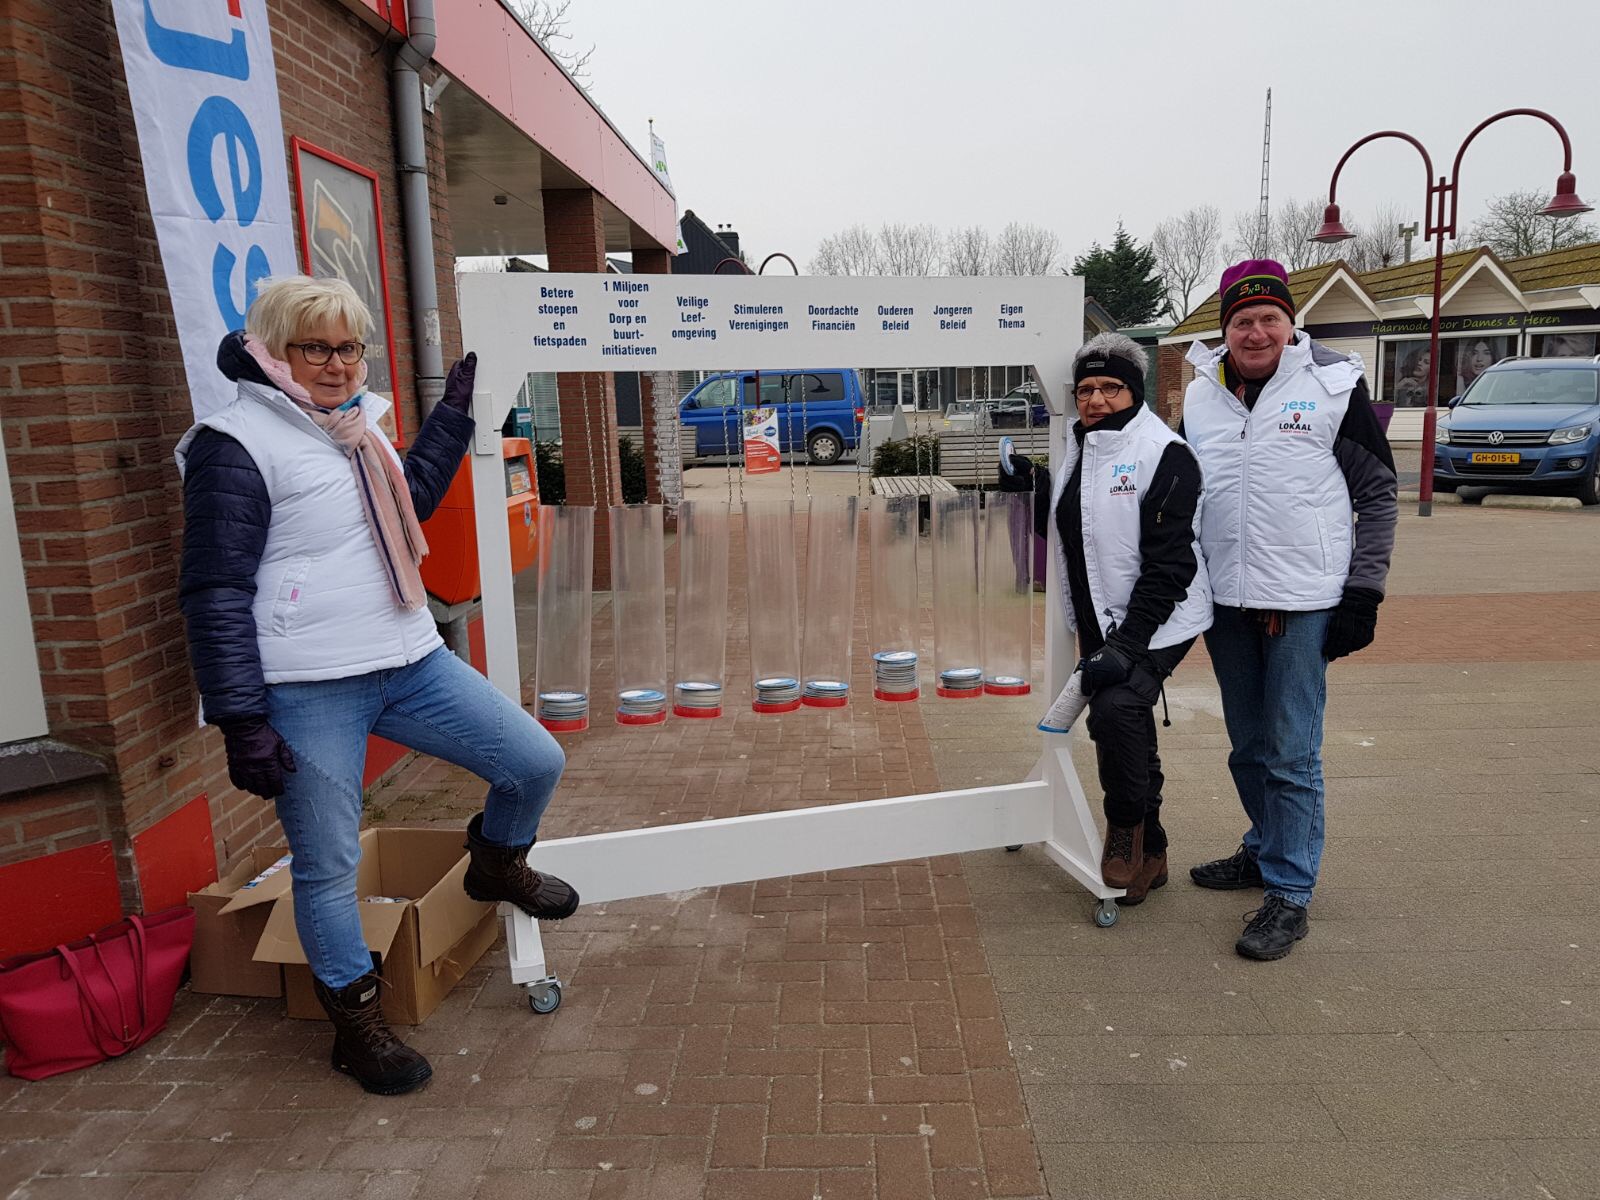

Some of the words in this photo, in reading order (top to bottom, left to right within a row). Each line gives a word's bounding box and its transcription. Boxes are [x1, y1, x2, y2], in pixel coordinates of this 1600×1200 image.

[540, 287, 574, 299] Betere
[603, 282, 609, 293] 1
[612, 281, 649, 294] Miljoen
[617, 299, 639, 308] voor
[676, 296, 709, 309] Veilige
[538, 303, 578, 316] stoepen
[733, 303, 784, 315] Stimuleren
[808, 304, 859, 316] Doordachte
[877, 305, 914, 316] Ouderen
[933, 305, 973, 317] Jongeren
[1000, 304, 1024, 316] Eigen
[609, 313, 632, 326] Dorp
[635, 315, 647, 324] en
[681, 312, 706, 323] Leef-
[998, 318, 1026, 329] Thema
[1372, 320, 1429, 333] Haarmode
[1439, 320, 1459, 330] oor
[1463, 318, 1502, 329] Dames
[1507, 316, 1518, 326] &
[1523, 314, 1561, 326] Heren
[553, 321, 566, 331] en
[728, 319, 789, 332] Verenigingen
[812, 319, 856, 331] Financiën
[882, 321, 910, 331] Beleid
[940, 319, 967, 330] Beleid
[613, 329, 645, 340] buurt-
[671, 328, 717, 341] omgeving
[533, 335, 587, 348] fietspaden
[602, 345, 657, 356] initiatieven
[1281, 400, 1316, 413] jess
[1279, 422, 1313, 432] LOKAAL
[1475, 454, 1515, 463] GH-015-L
[1109, 484, 1137, 494] LOKAAL
